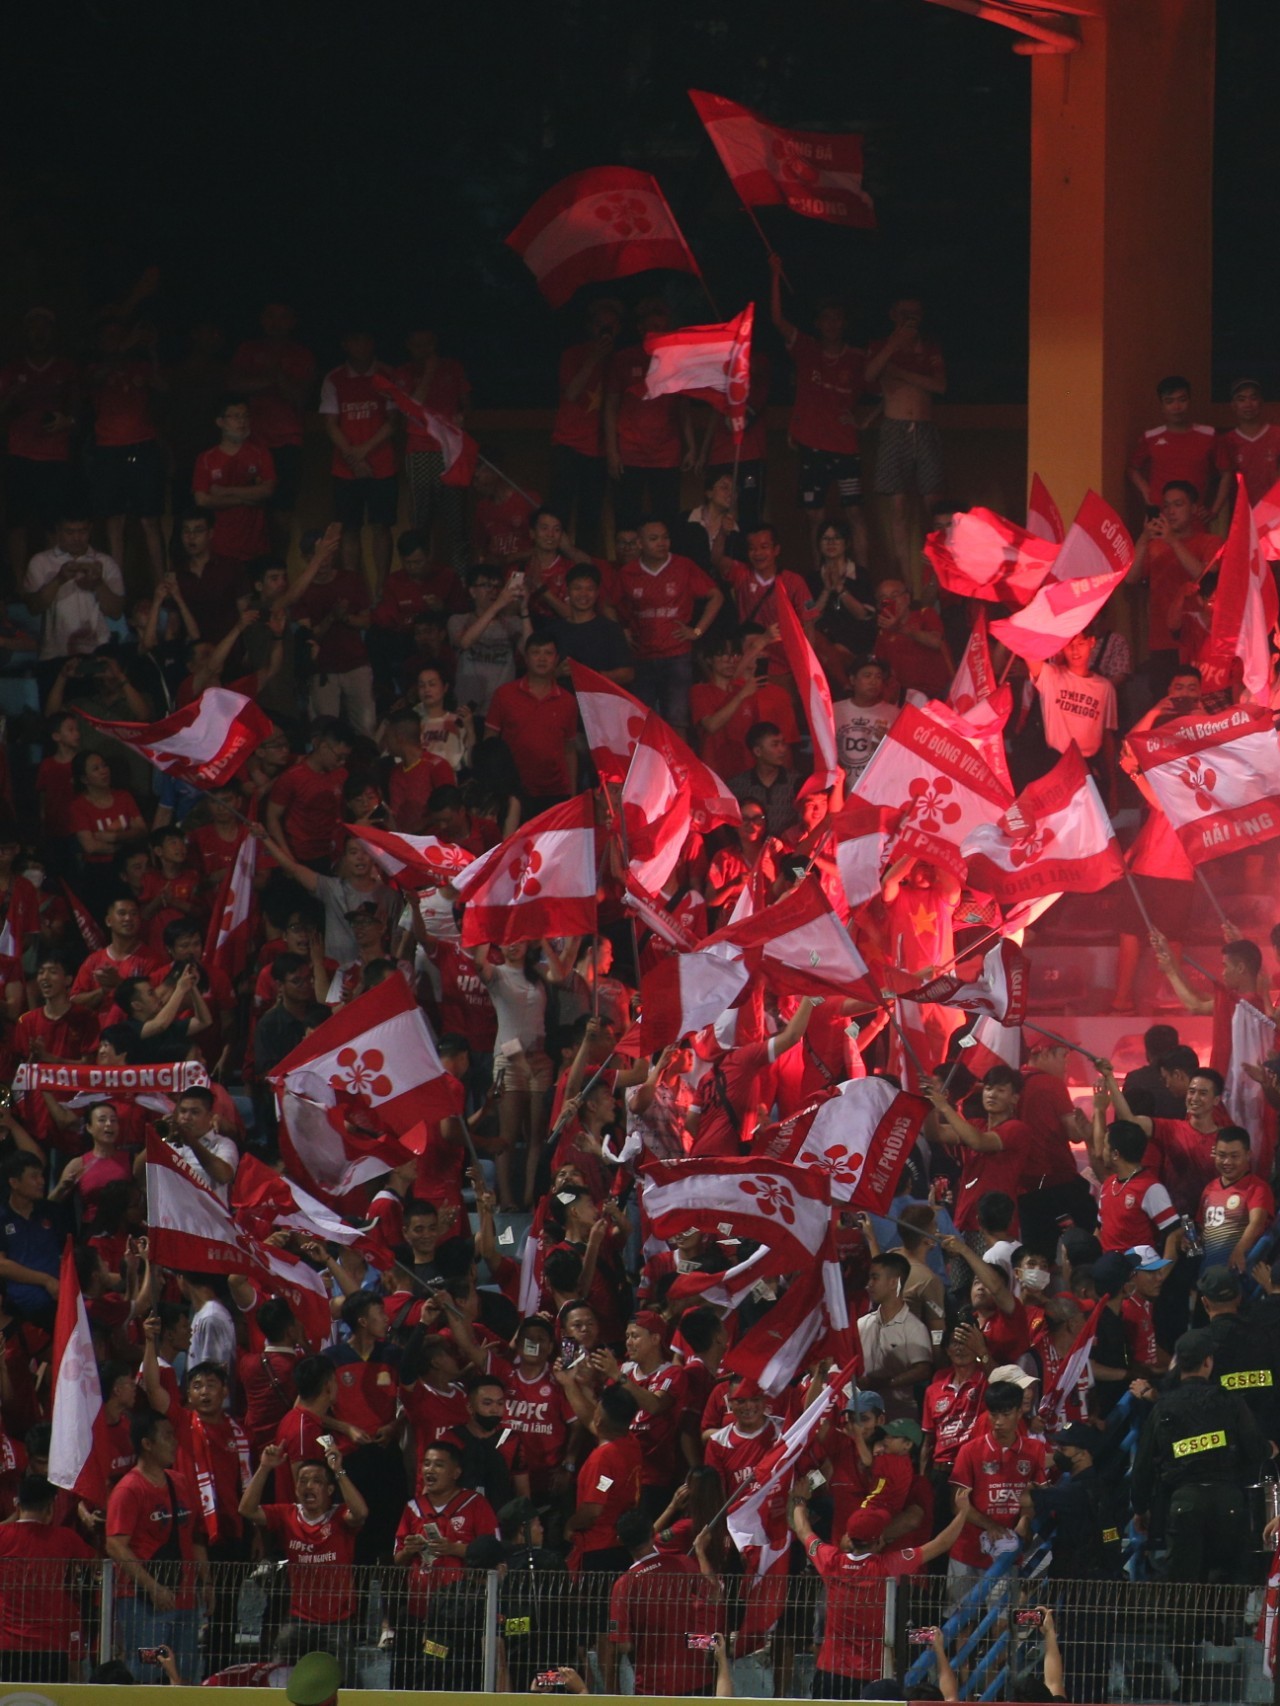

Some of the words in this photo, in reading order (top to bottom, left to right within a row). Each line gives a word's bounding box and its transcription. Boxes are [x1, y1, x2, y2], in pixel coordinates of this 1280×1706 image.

[846, 738, 867, 752] DG
[928, 734, 961, 763] ĐỘNG
[879, 1116, 912, 1171] PHÒNG
[1226, 1371, 1267, 1388] CSCĐ
[1178, 1433, 1220, 1454] CSCĐ
[988, 1489, 1020, 1503] USA
